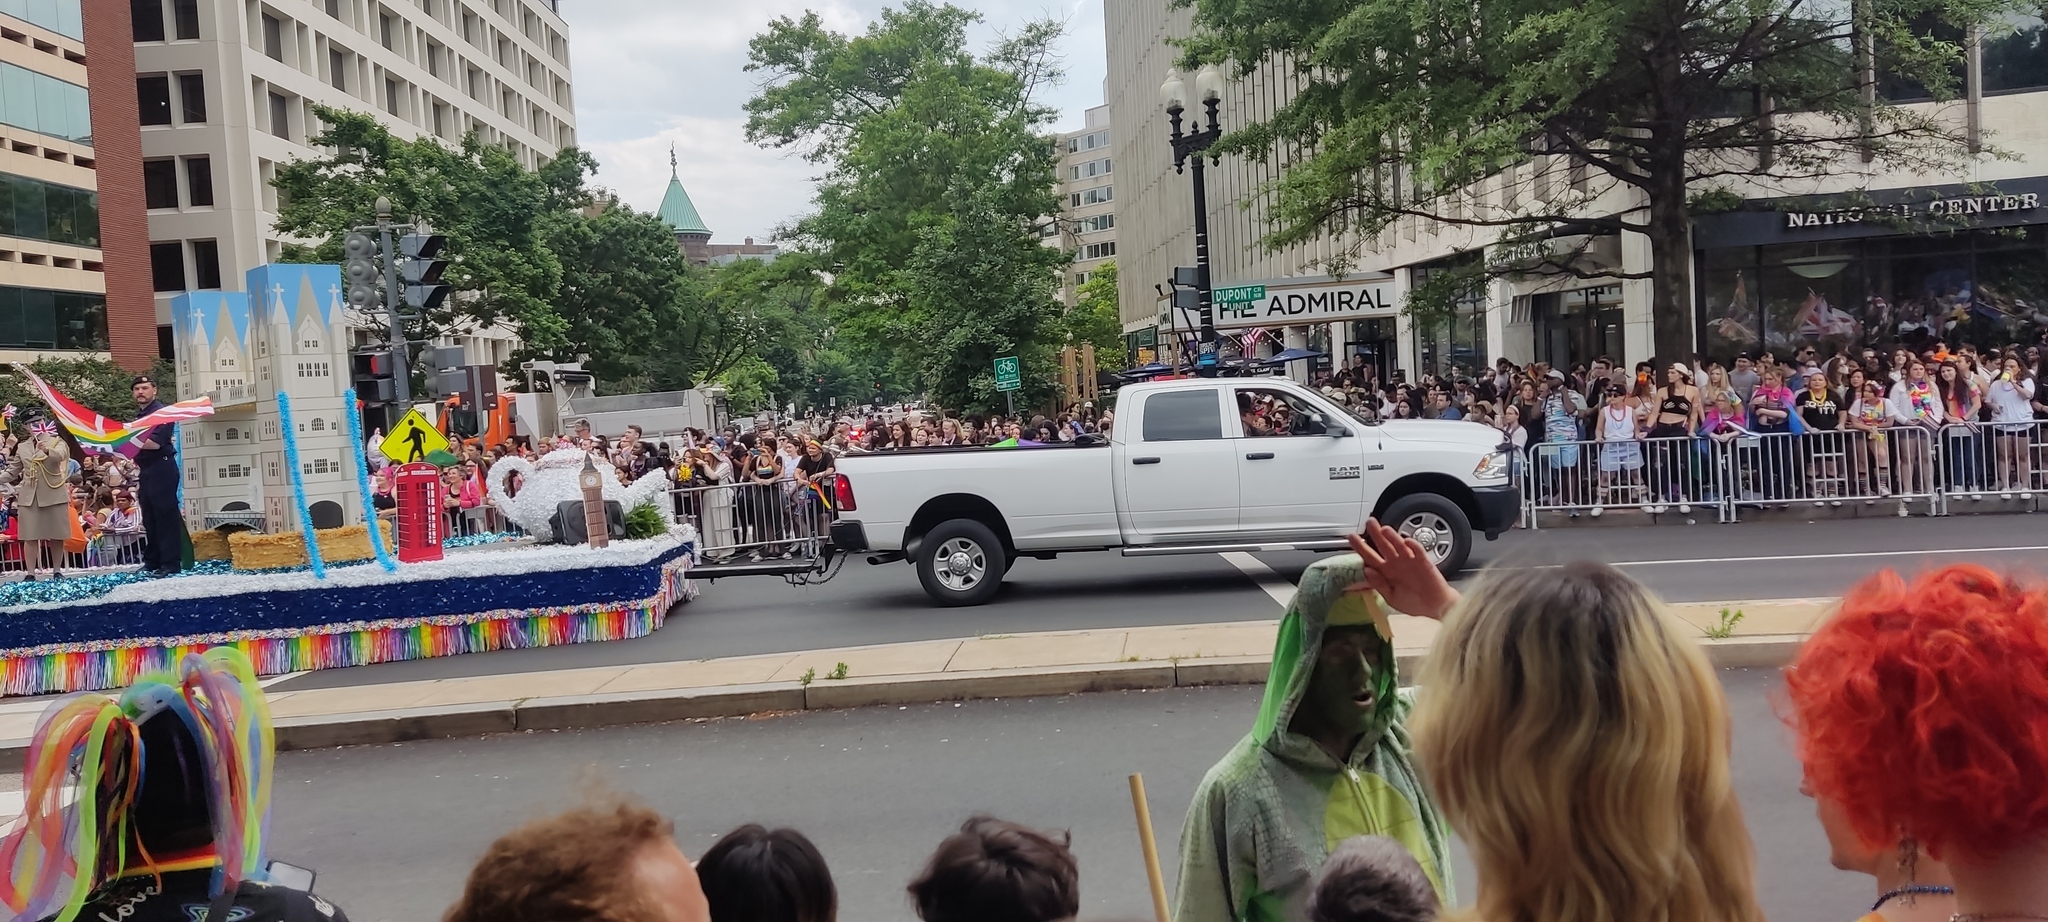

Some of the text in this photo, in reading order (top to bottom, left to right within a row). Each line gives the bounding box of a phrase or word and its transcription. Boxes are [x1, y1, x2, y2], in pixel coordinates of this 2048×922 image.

[1787, 192, 2040, 227] NATIOL CENTER
[1215, 287, 1252, 302] DUPONT
[1267, 289, 1391, 316] ADMIRAL
[1819, 407, 1837, 415] ITY
